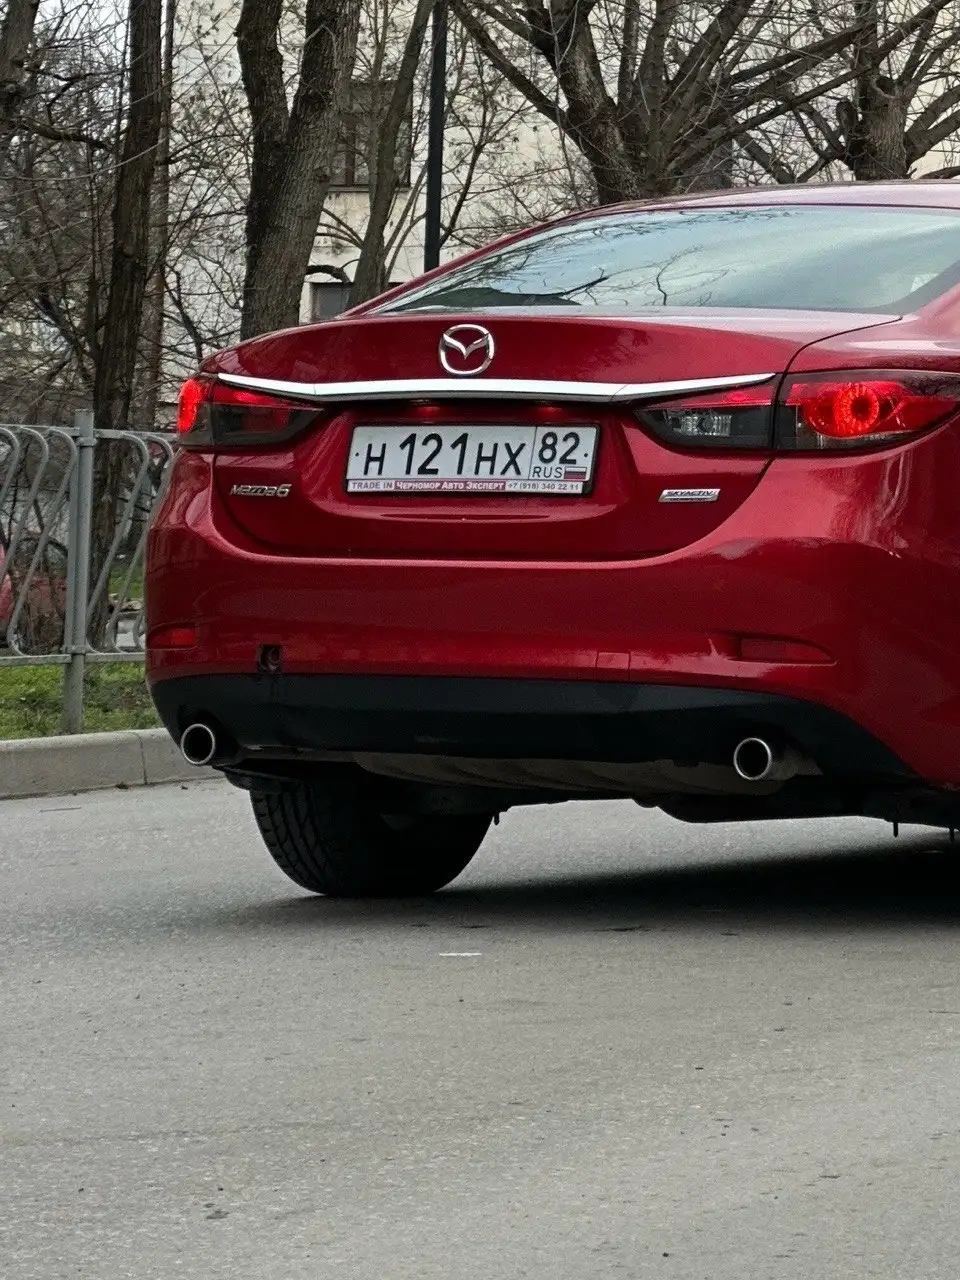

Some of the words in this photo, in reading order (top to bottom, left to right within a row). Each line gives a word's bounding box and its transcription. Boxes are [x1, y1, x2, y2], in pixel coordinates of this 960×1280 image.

[538, 431, 580, 465] 82
[531, 466, 563, 479] RUS
[351, 481, 381, 489] TRADE
[383, 481, 393, 489] IN
[557, 483, 568, 491] 22
